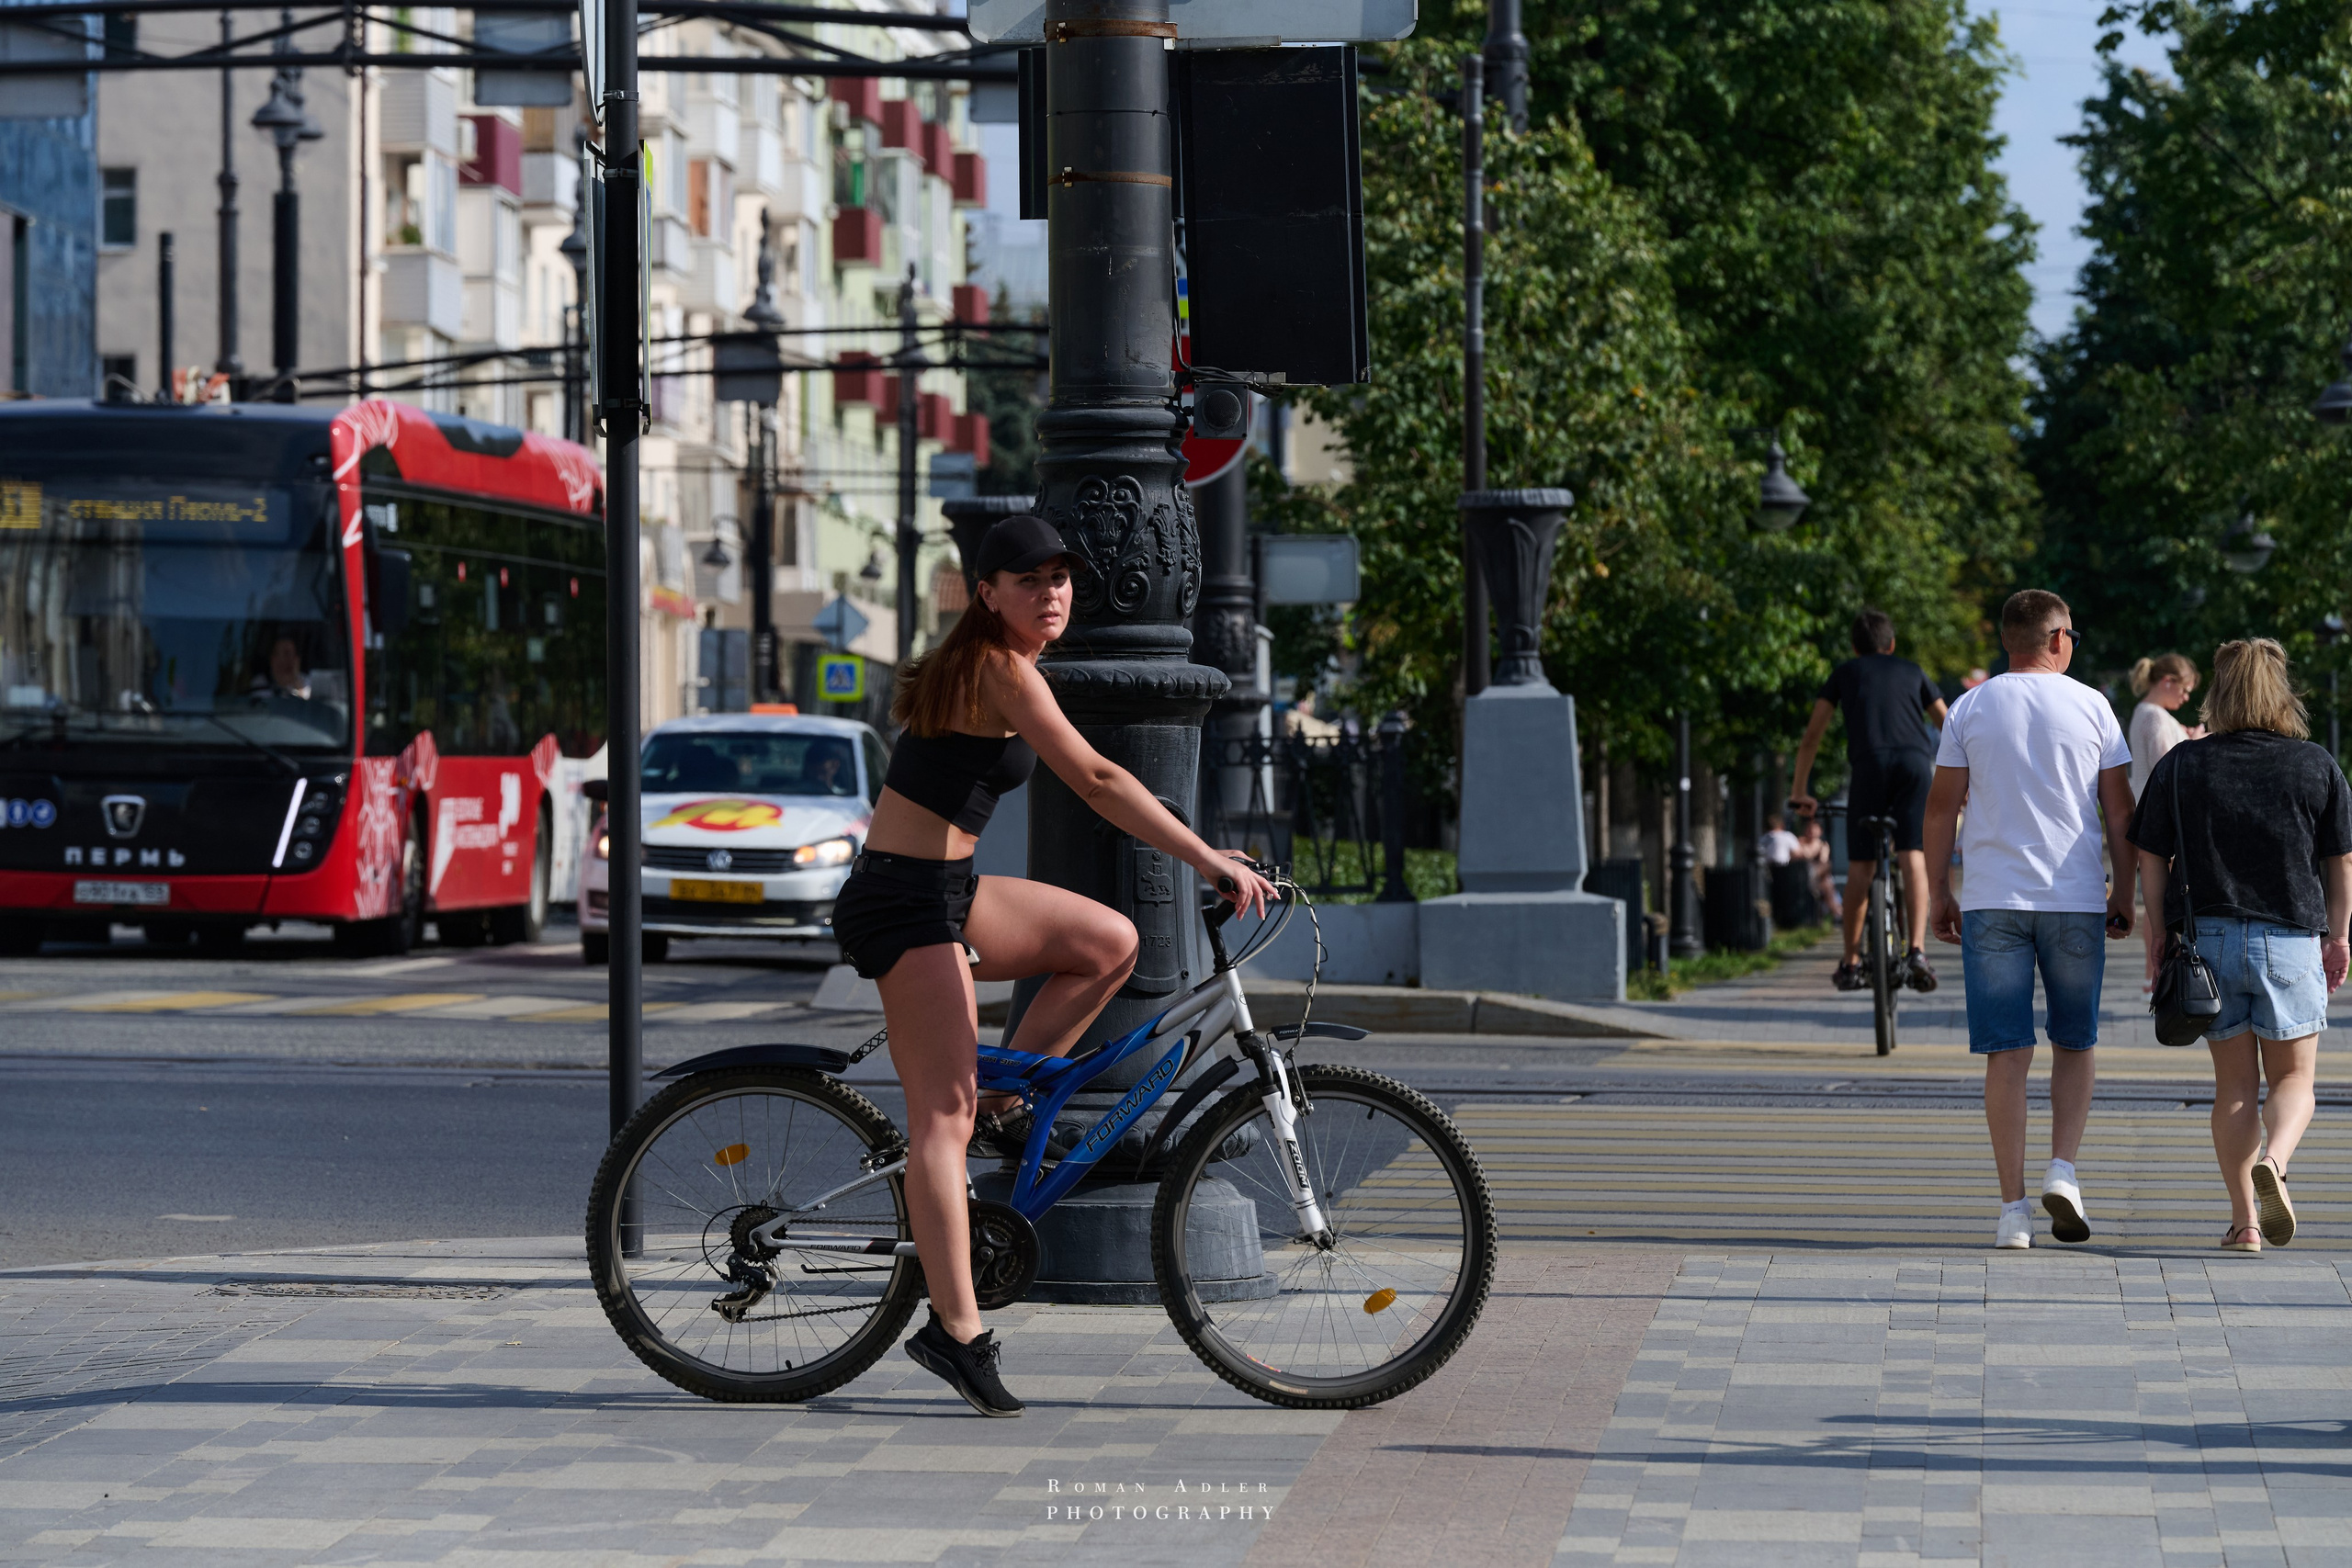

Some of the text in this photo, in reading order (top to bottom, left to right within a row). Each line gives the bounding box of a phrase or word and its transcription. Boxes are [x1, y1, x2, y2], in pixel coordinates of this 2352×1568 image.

[64, 846, 186, 866] ПЕРМЬ
[977, 1054, 997, 1063] TOR
[1086, 1058, 1175, 1154] FORWARD
[1289, 1142, 1309, 1187] ZOOM
